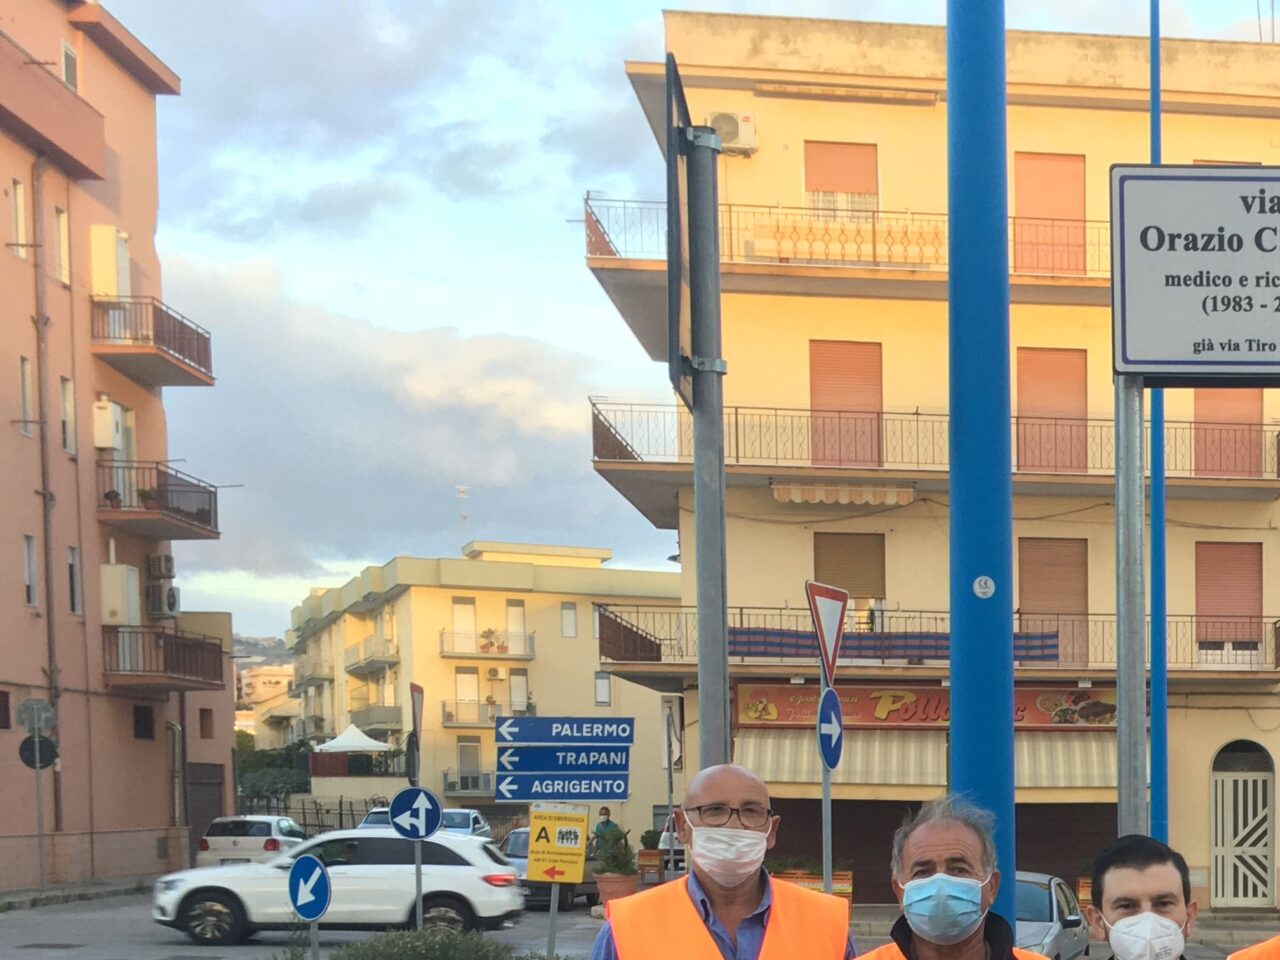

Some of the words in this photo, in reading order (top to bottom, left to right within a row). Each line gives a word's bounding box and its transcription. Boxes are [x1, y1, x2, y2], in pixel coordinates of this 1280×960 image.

[1139, 225, 1244, 252] Orazio
[1164, 271, 1233, 288] medico
[1238, 275, 1249, 288] e
[1201, 295, 1254, 316] (1983
[1192, 338, 1215, 355] già
[1219, 339, 1241, 352] via
[1244, 339, 1277, 352] Tiro
[551, 723, 631, 737] PALERMO
[556, 752, 626, 765] TRAPANI
[531, 780, 625, 793] AGRIGENTO
[535, 826, 550, 843] A
